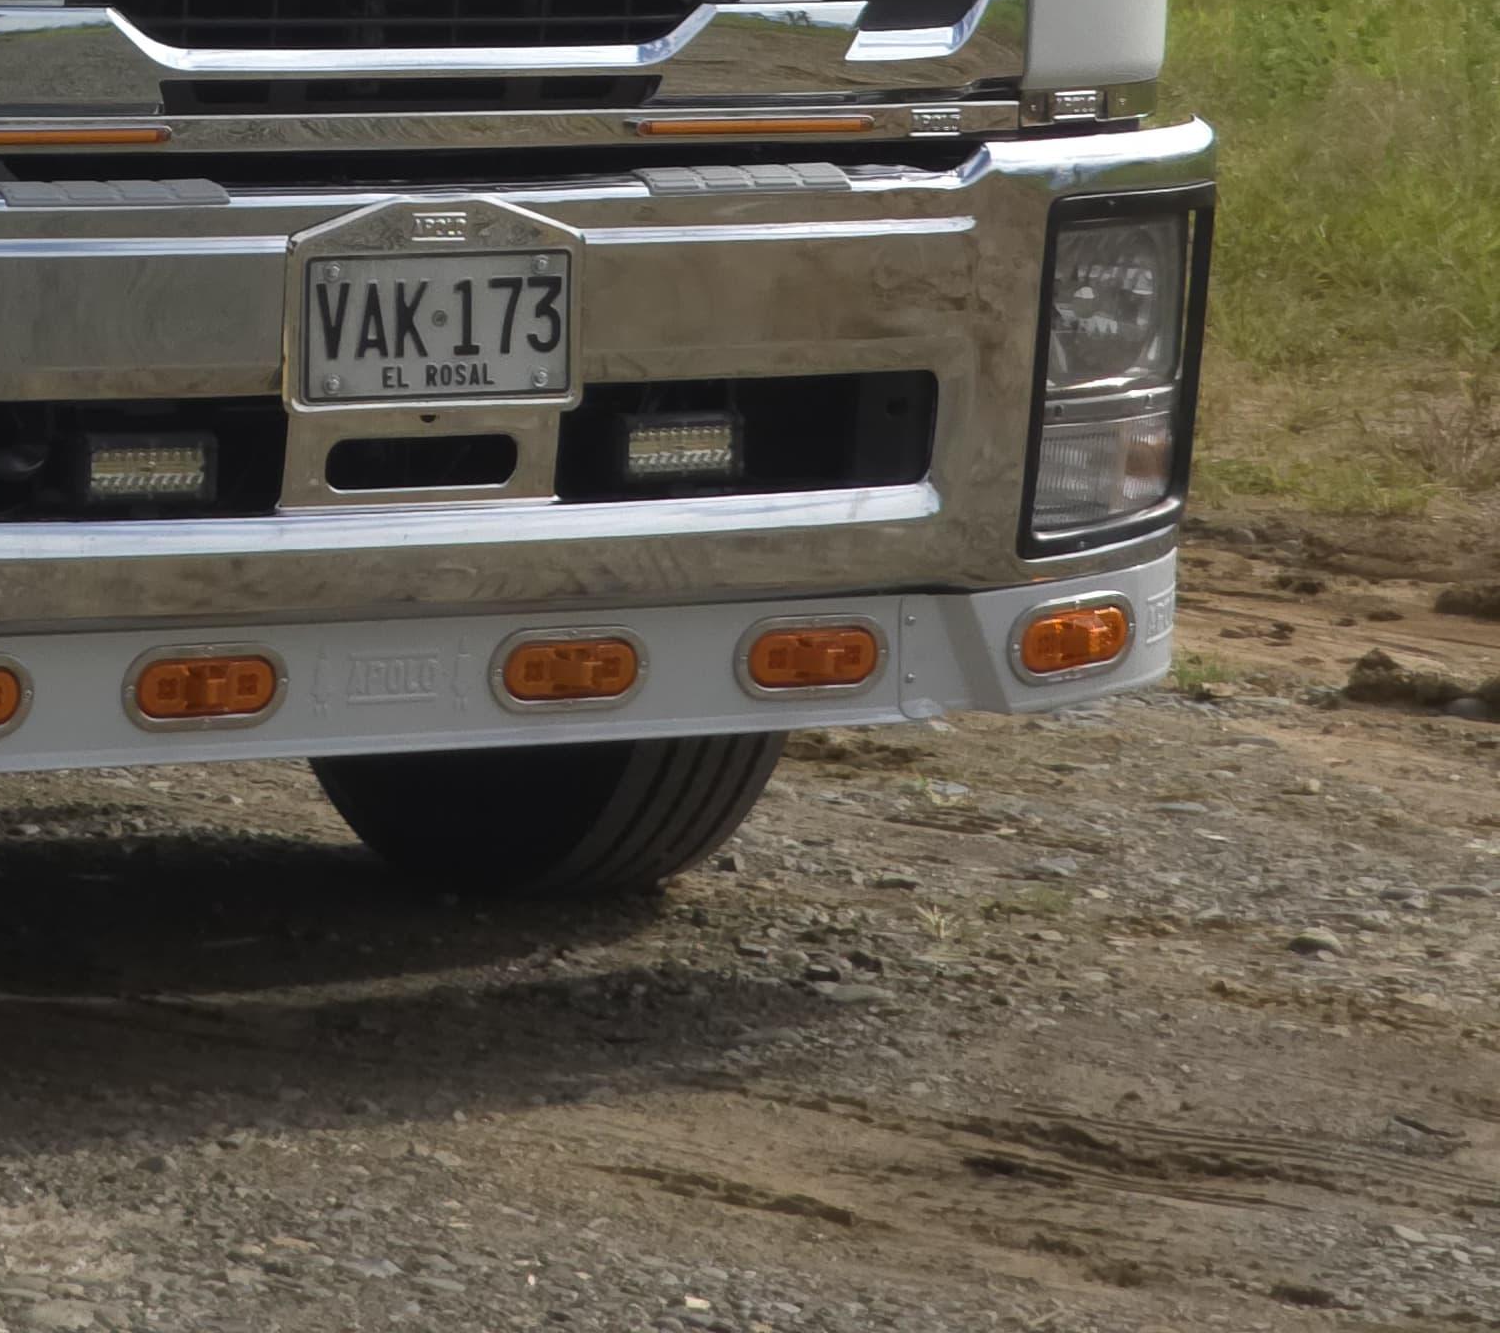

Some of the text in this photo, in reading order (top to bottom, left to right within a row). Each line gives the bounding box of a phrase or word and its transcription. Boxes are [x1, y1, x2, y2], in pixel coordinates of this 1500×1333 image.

[317, 276, 563, 360] VAK 173
[381, 363, 495, 389] EL ROSAL
